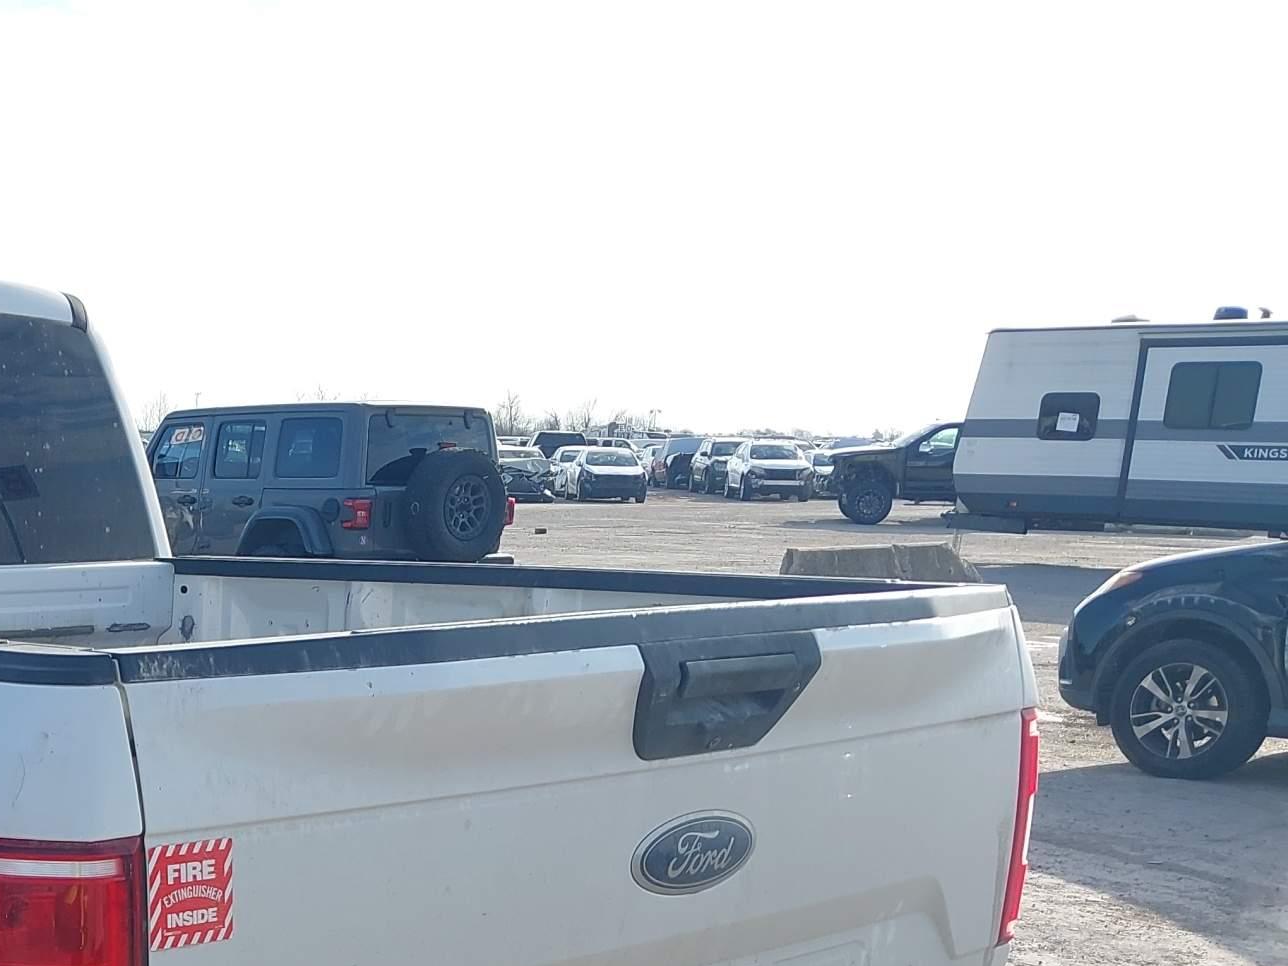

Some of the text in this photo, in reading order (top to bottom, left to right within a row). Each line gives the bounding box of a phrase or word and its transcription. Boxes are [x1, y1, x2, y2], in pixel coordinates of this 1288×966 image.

[1243, 447, 1288, 459] KINGS
[667, 830, 735, 878] Ford
[167, 858, 216, 885] FIRE
[163, 884, 223, 908] EXTINGUISHER
[167, 907, 218, 929] INSIDE
